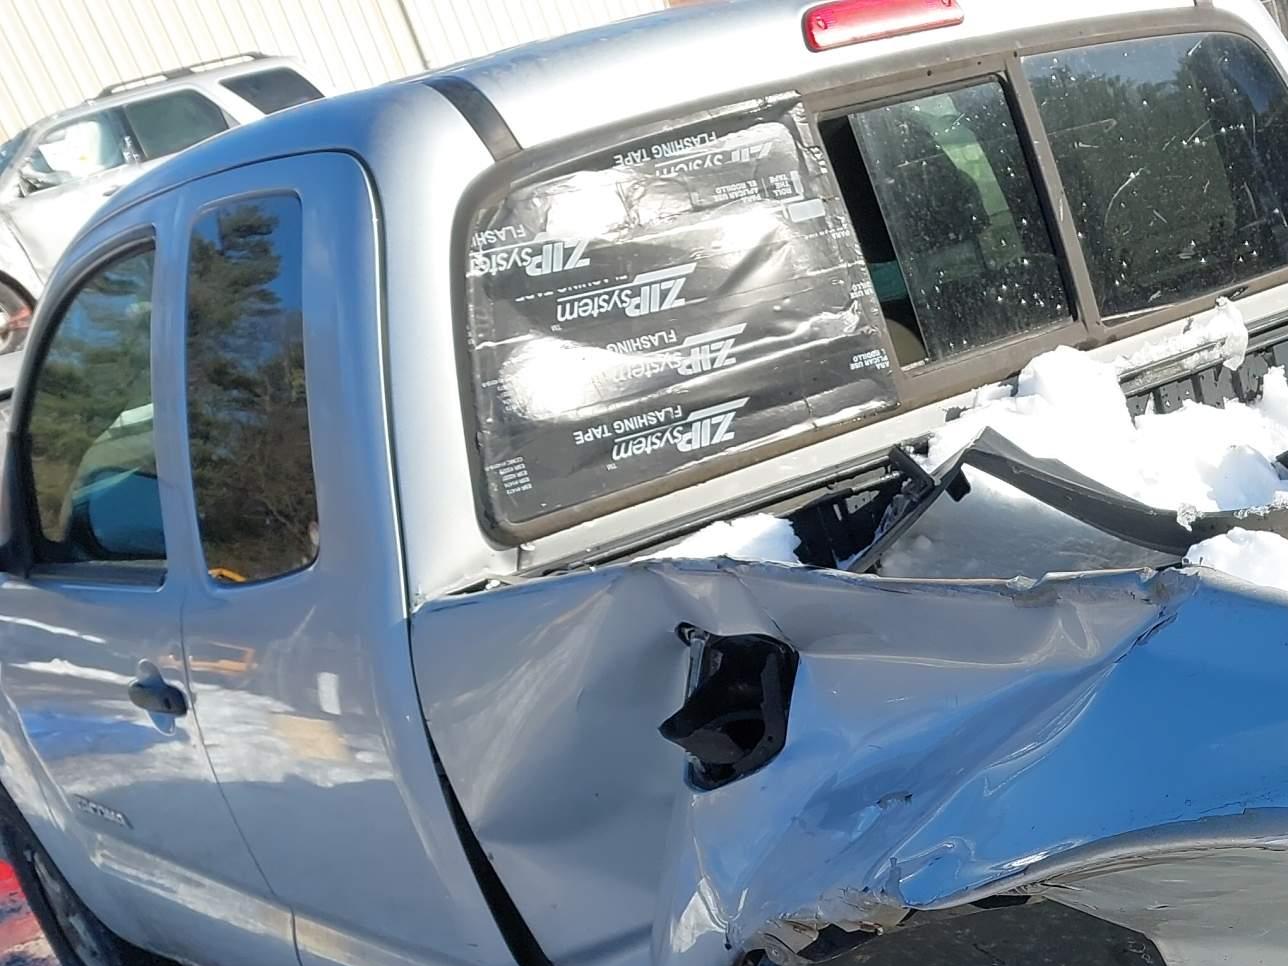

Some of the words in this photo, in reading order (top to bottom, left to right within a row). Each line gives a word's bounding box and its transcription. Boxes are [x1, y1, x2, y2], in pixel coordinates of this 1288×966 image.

[613, 142, 653, 167] TAPE
[651, 130, 718, 159] FLASHING
[556, 276, 687, 322] ZIPsystem
[606, 329, 678, 353] FLASHING
[612, 404, 683, 434] FLASHING
[572, 425, 613, 446] TAPE
[611, 411, 737, 461] ZIPsystem
